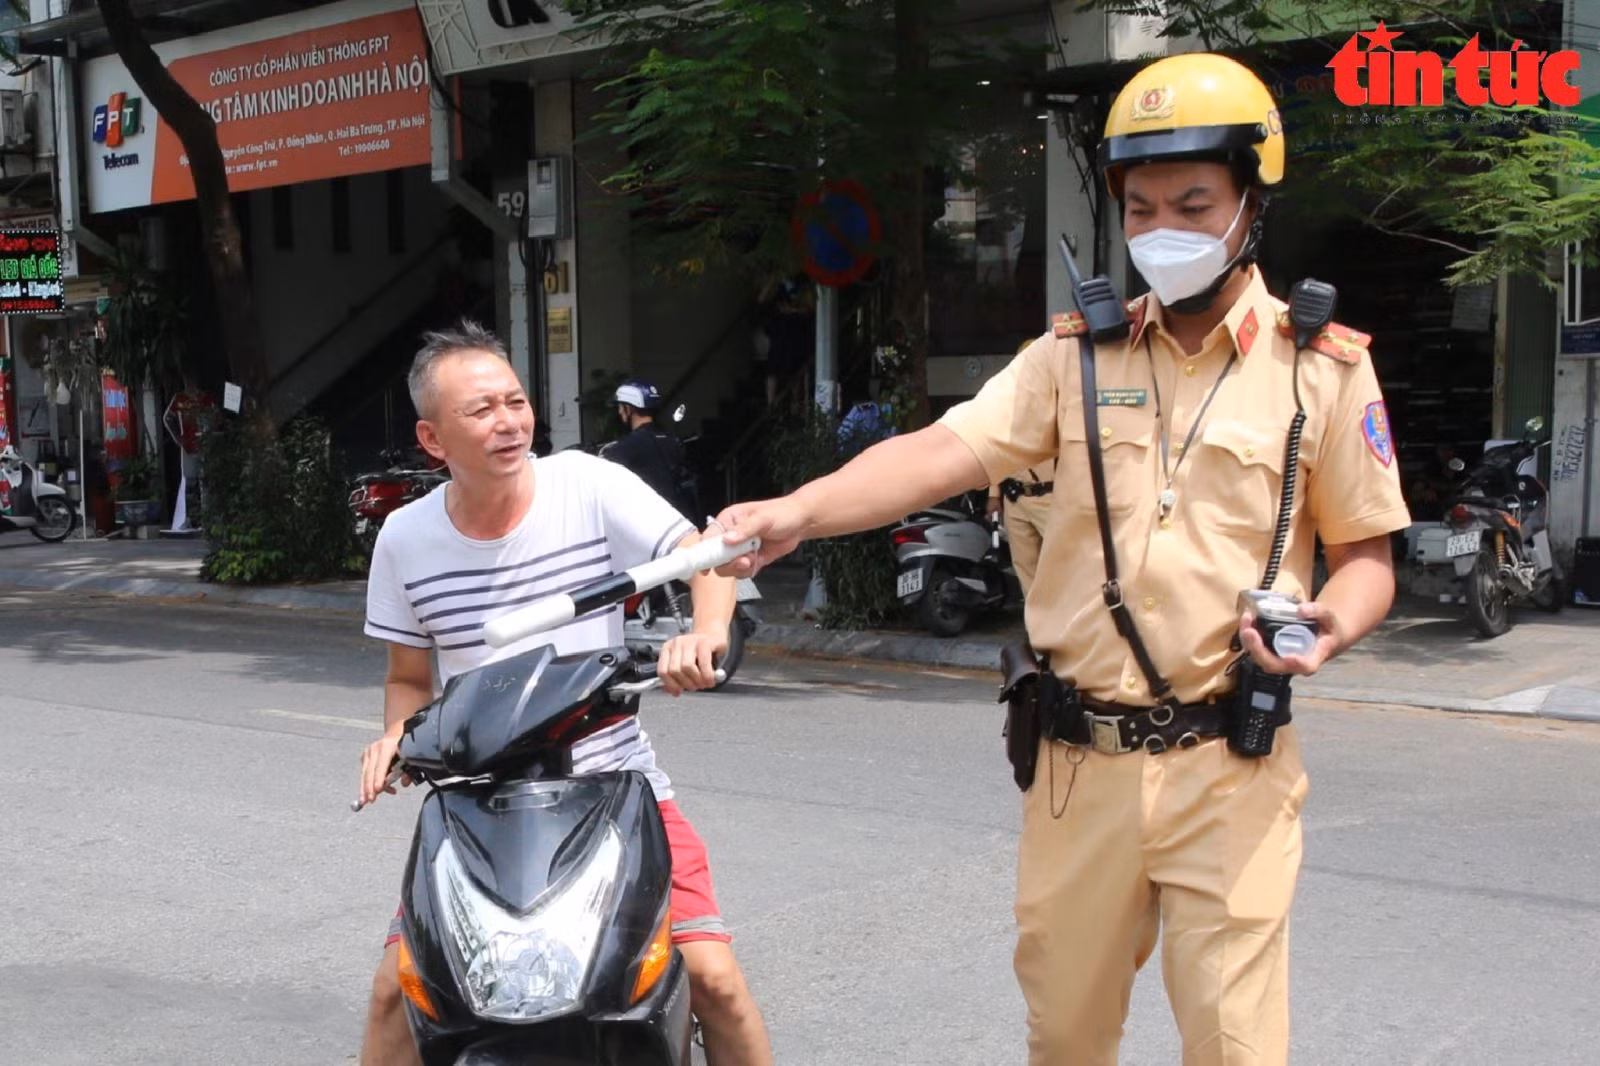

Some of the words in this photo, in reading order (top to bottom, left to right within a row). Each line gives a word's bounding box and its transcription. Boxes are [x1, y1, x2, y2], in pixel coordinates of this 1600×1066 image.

[209, 67, 237, 87] CÔNG
[238, 65, 252, 80] TY
[328, 40, 367, 63] THÔNG
[369, 35, 390, 53] FPT
[224, 91, 258, 120] TÂM
[260, 87, 300, 116] KINH
[301, 70, 363, 108] DOANH
[366, 61, 393, 94] HÀ
[395, 55, 430, 93] NỘI
[102, 152, 139, 171] Telecom
[497, 191, 526, 217] 59
